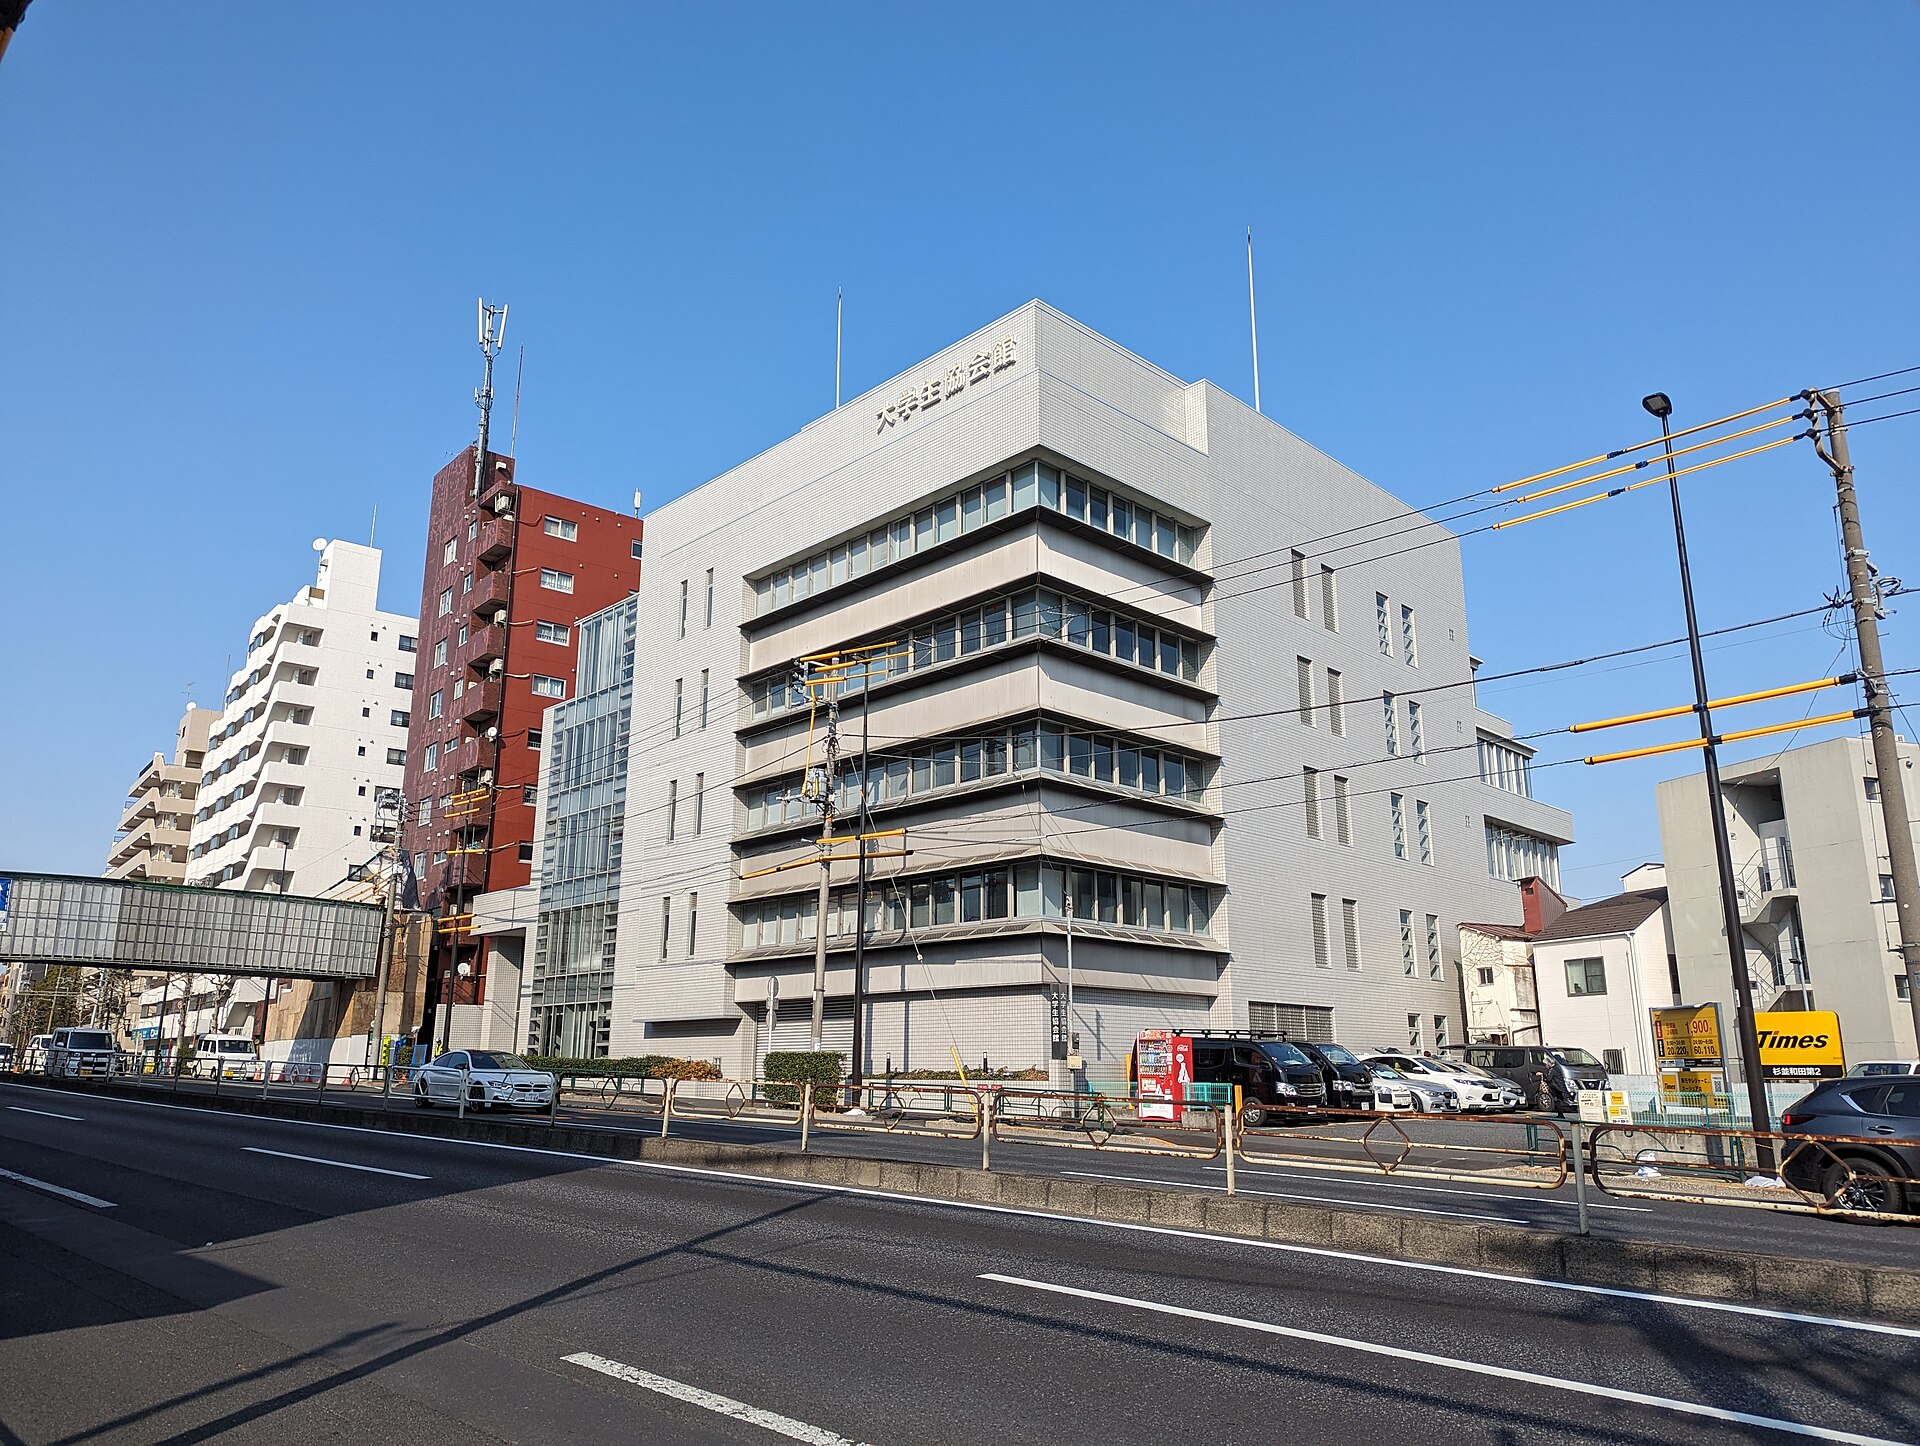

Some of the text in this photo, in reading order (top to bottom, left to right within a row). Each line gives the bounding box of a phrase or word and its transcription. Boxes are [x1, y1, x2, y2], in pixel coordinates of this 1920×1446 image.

[876, 334, 1017, 435] 大学生協会館
[1757, 1031, 1829, 1048] Times
[1772, 1067, 1822, 1076] 杉並和田第2
